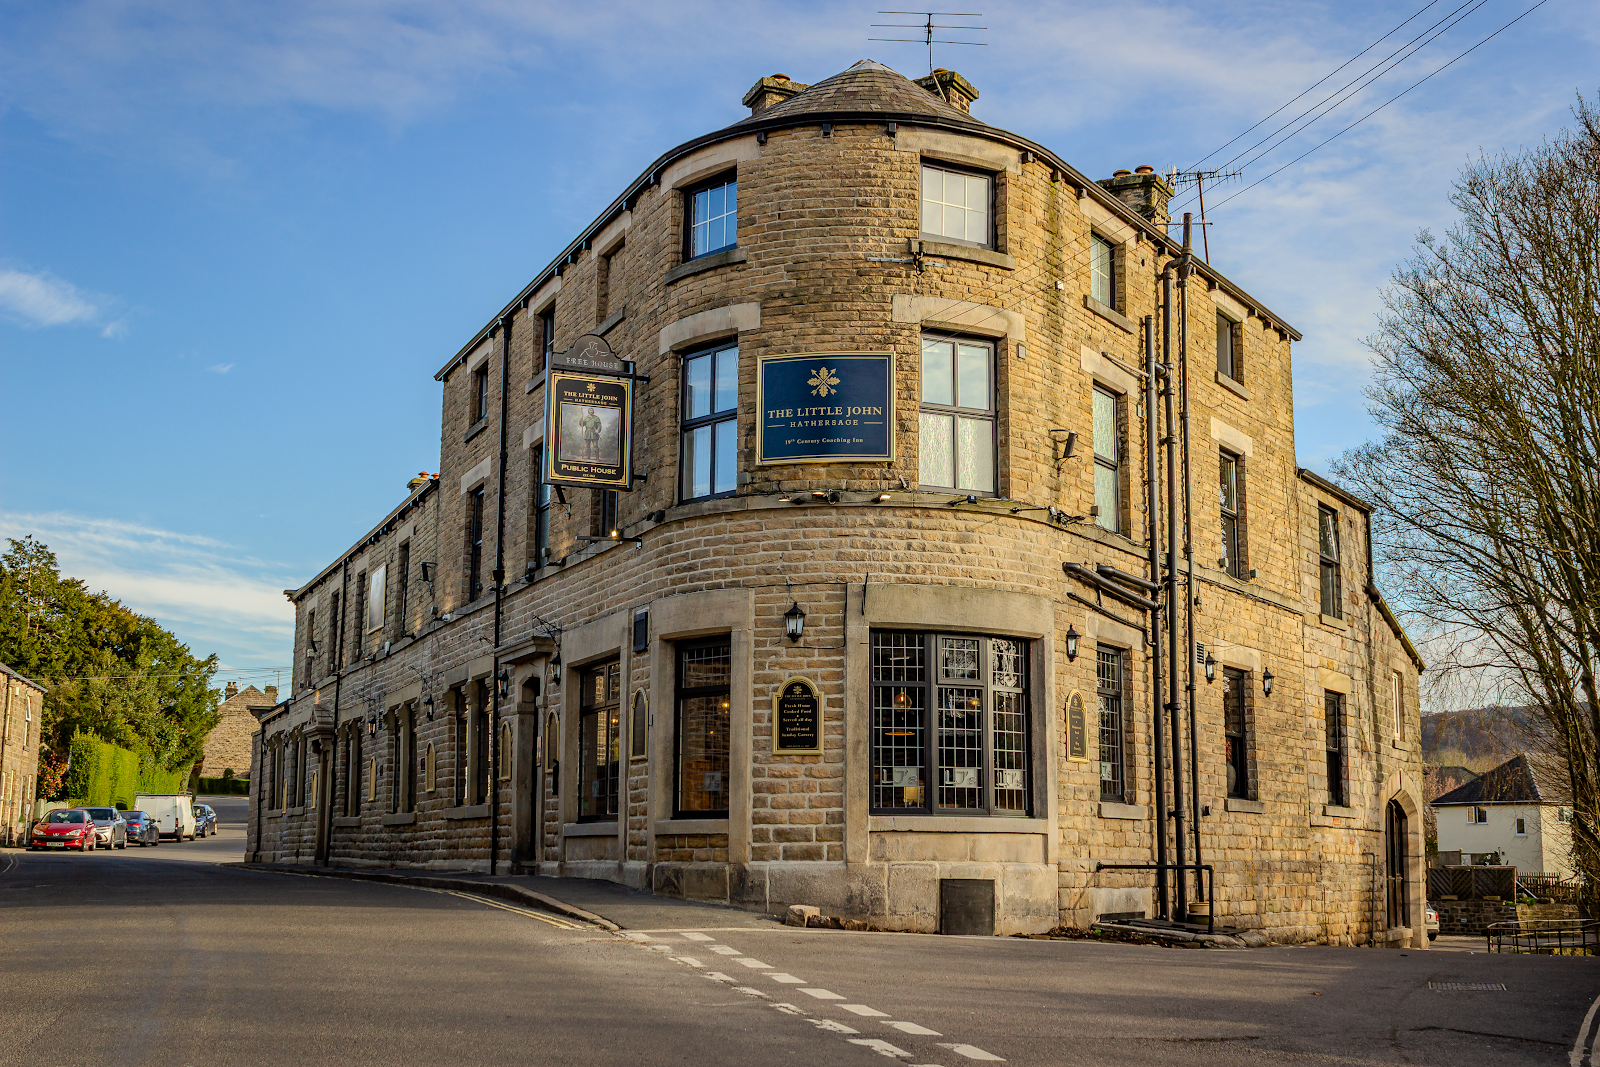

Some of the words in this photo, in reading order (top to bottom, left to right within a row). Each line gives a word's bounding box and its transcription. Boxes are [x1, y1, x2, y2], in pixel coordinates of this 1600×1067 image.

[565, 357, 589, 366] FREE
[591, 360, 619, 369] HOUSE
[578, 392, 600, 400] LITTLE
[601, 394, 618, 402] JOHN
[767, 408, 794, 419] THE
[796, 406, 843, 417] LITTLE
[846, 406, 883, 417] JOHN
[789, 419, 859, 428] HATHERSAGE
[562, 464, 588, 472] PUBLIC
[590, 466, 617, 475] HOUSE
